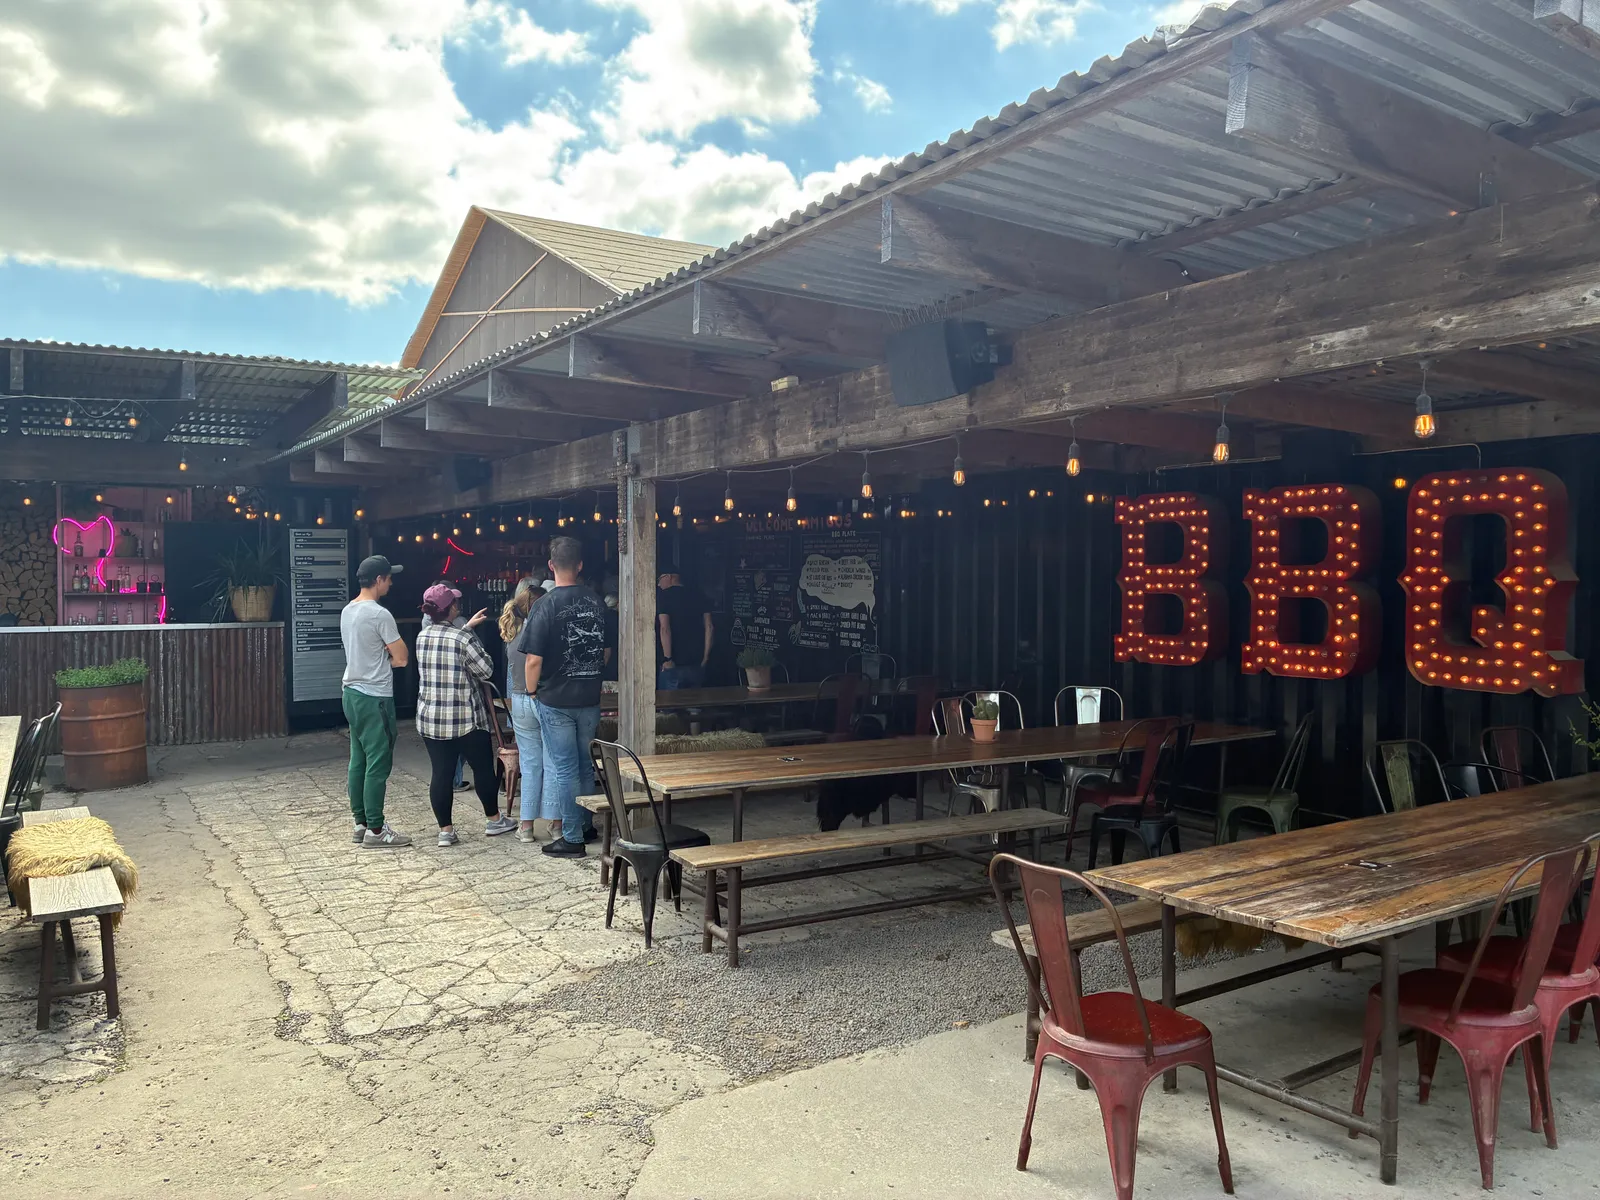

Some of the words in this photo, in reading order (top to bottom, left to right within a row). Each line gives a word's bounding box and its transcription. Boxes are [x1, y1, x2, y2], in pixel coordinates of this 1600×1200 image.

[746, 518, 794, 532] WELCOME
[801, 513, 853, 530] AMIGOS
[1114, 467, 1585, 697] BBQ
